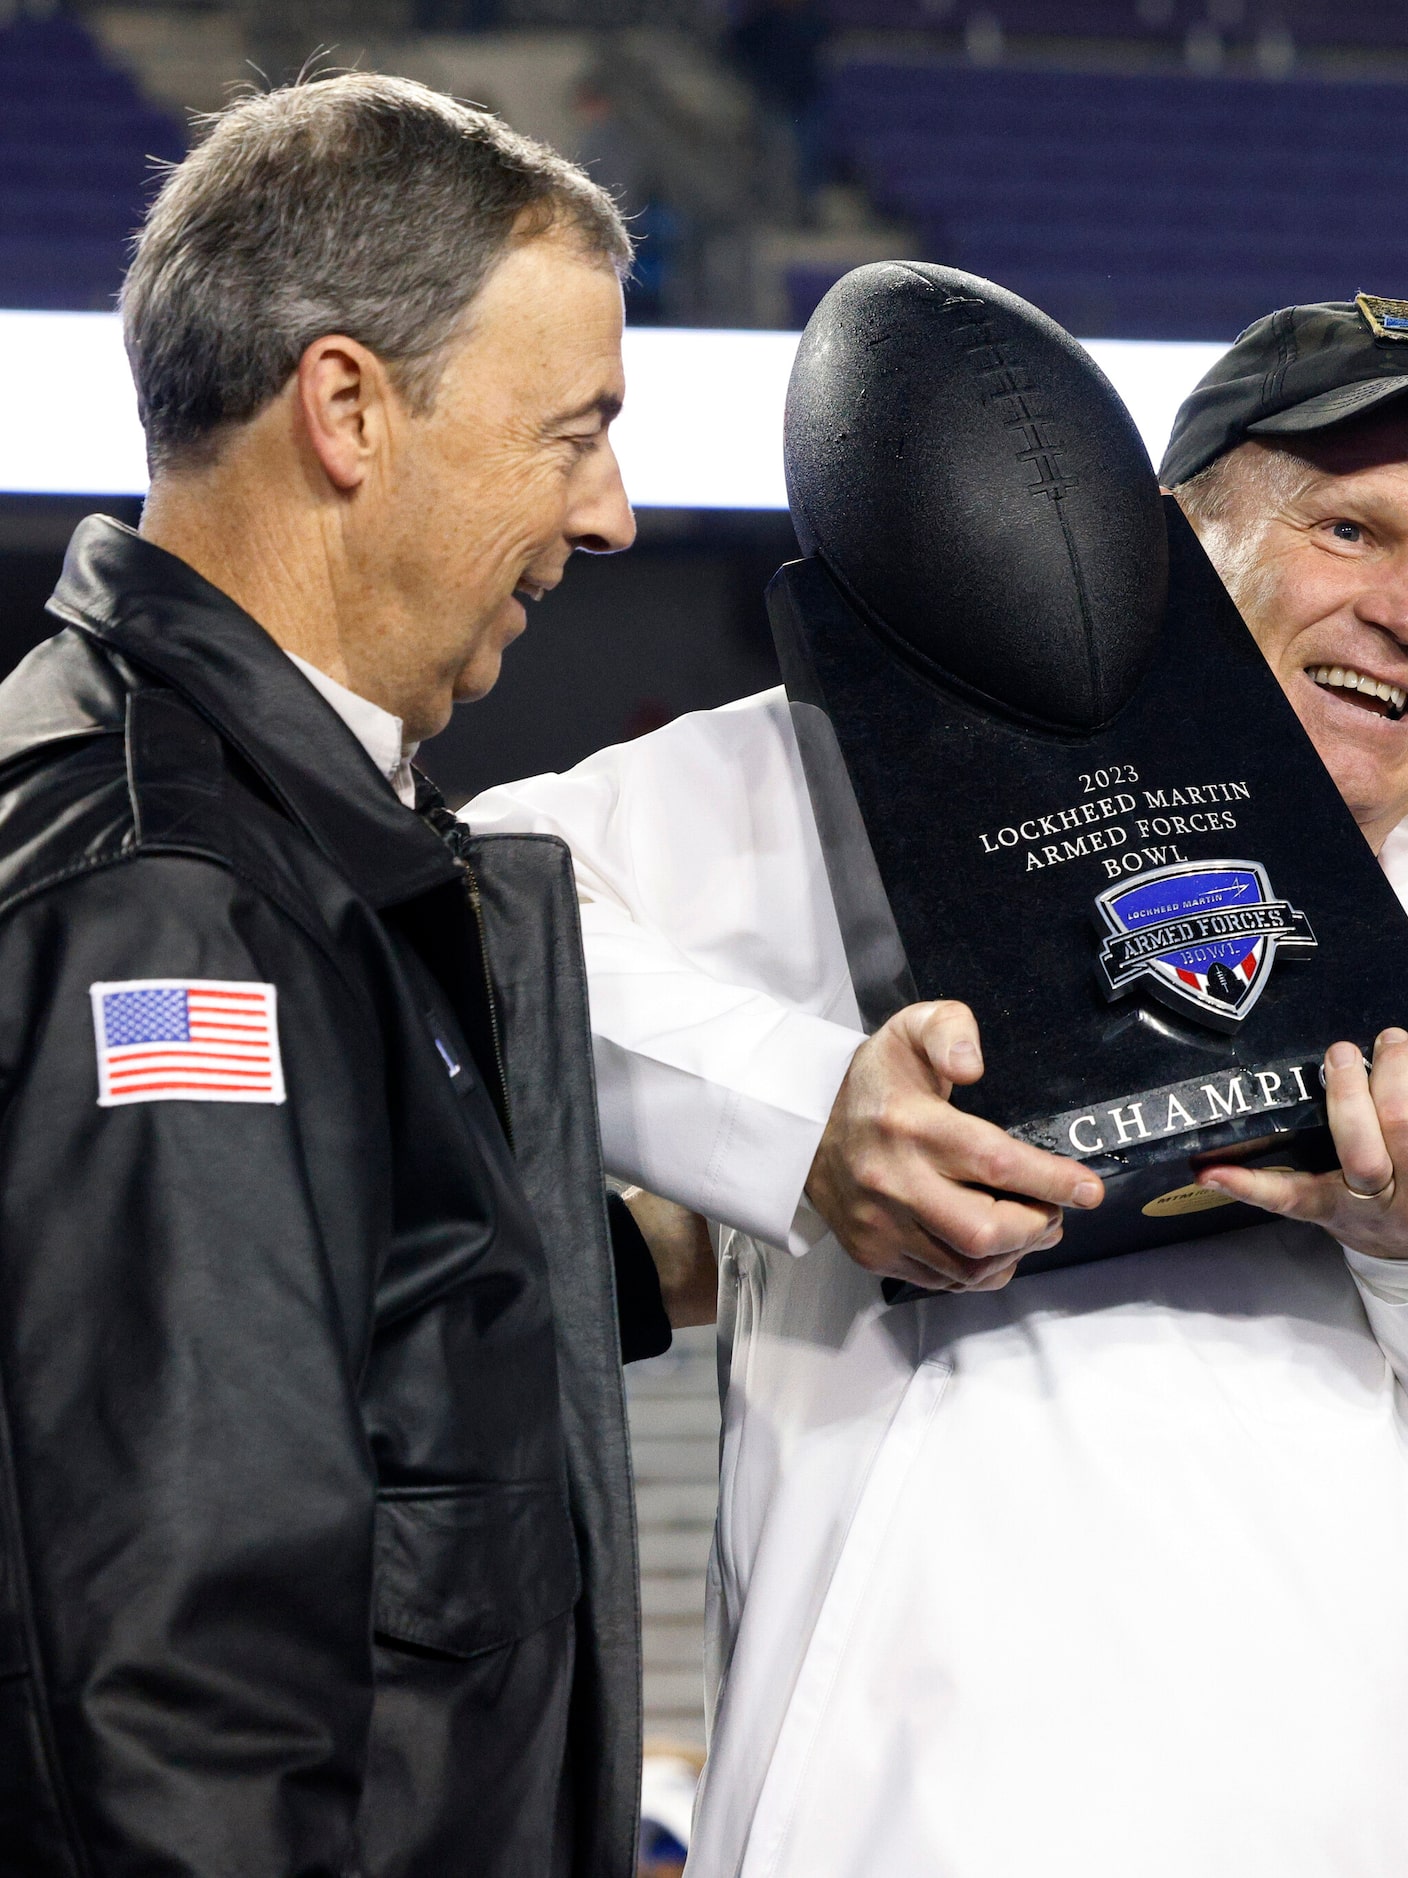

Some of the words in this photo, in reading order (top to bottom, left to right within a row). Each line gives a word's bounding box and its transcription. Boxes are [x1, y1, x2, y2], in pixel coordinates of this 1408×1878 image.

[1078, 764, 1140, 793] 2023
[979, 793, 1136, 853] LOCKHEED
[1142, 781, 1251, 809] MARTIN
[1025, 826, 1128, 872] ARMED
[1135, 811, 1237, 838] FORCES
[1101, 844, 1189, 879] BOWL
[1127, 903, 1179, 921] LOCKHEED
[1182, 894, 1223, 908] MARTIN
[1124, 924, 1194, 960] ARMED
[1201, 910, 1284, 937] FORCES
[1181, 943, 1241, 965] BOWL
[1069, 1064, 1327, 1155] CHAMPI
